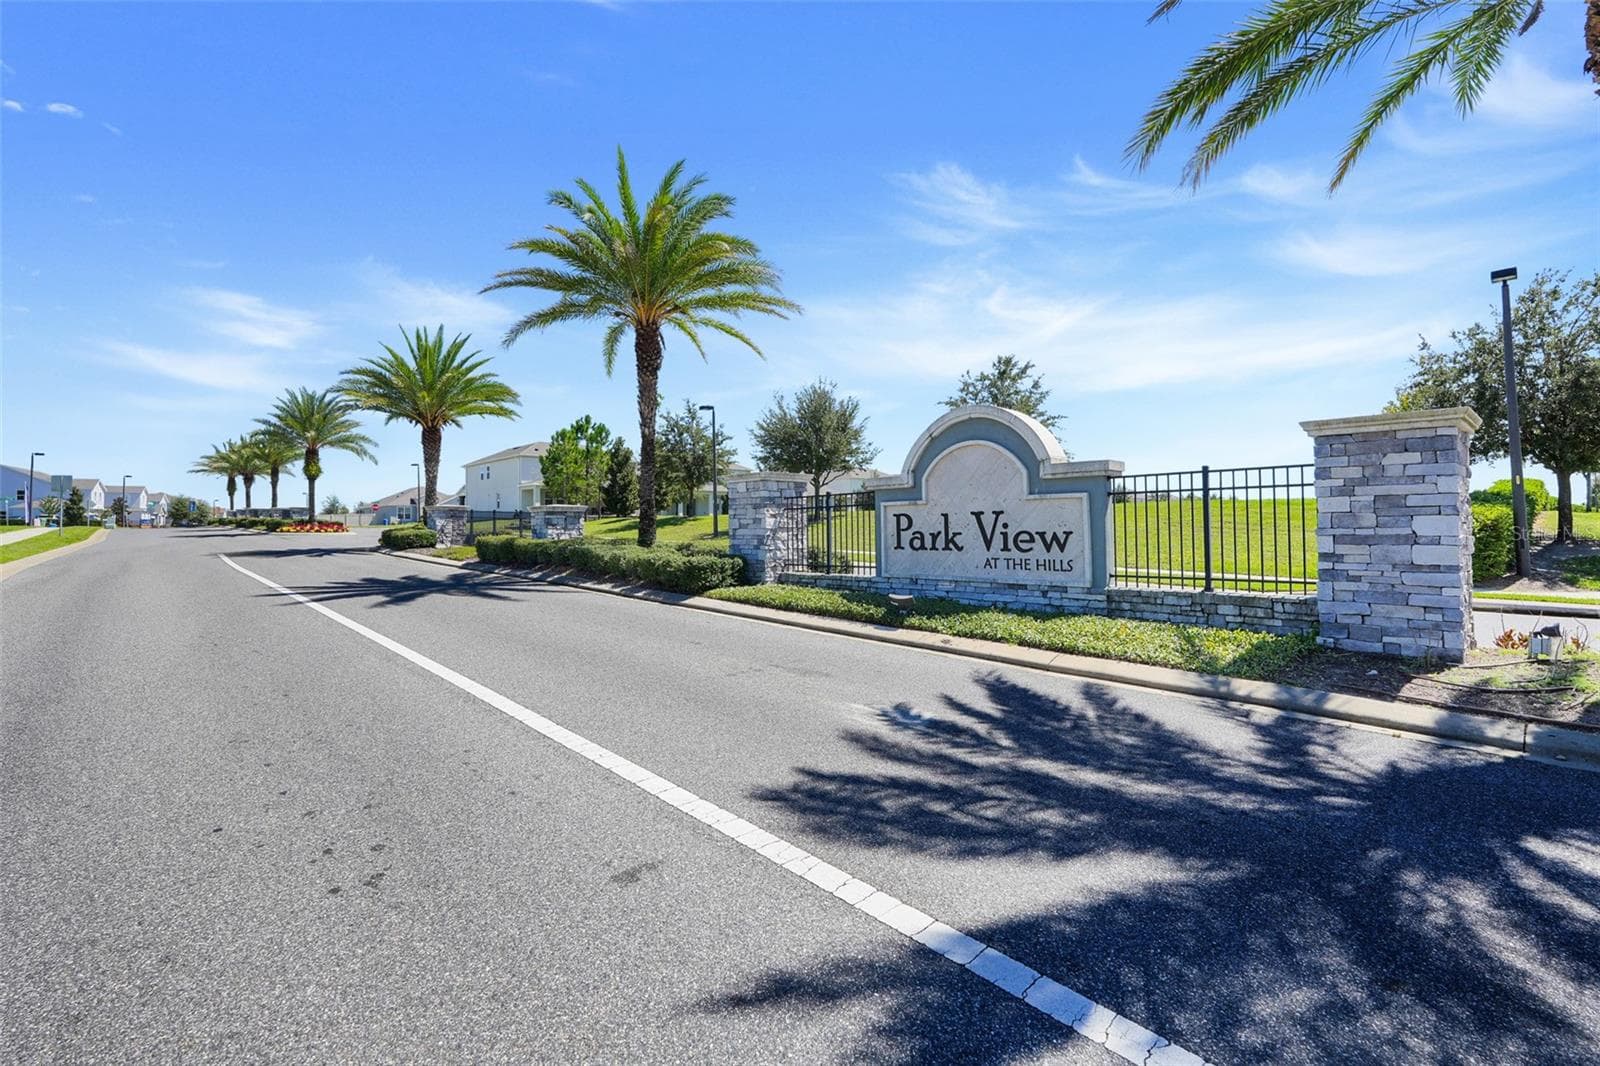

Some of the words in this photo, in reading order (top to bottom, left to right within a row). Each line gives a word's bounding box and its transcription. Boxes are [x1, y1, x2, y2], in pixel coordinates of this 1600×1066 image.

[893, 513, 964, 551] Park
[970, 510, 1074, 553] View
[983, 557, 1001, 570] AT
[1004, 557, 1031, 571] THE
[1036, 558, 1074, 572] HILLS
